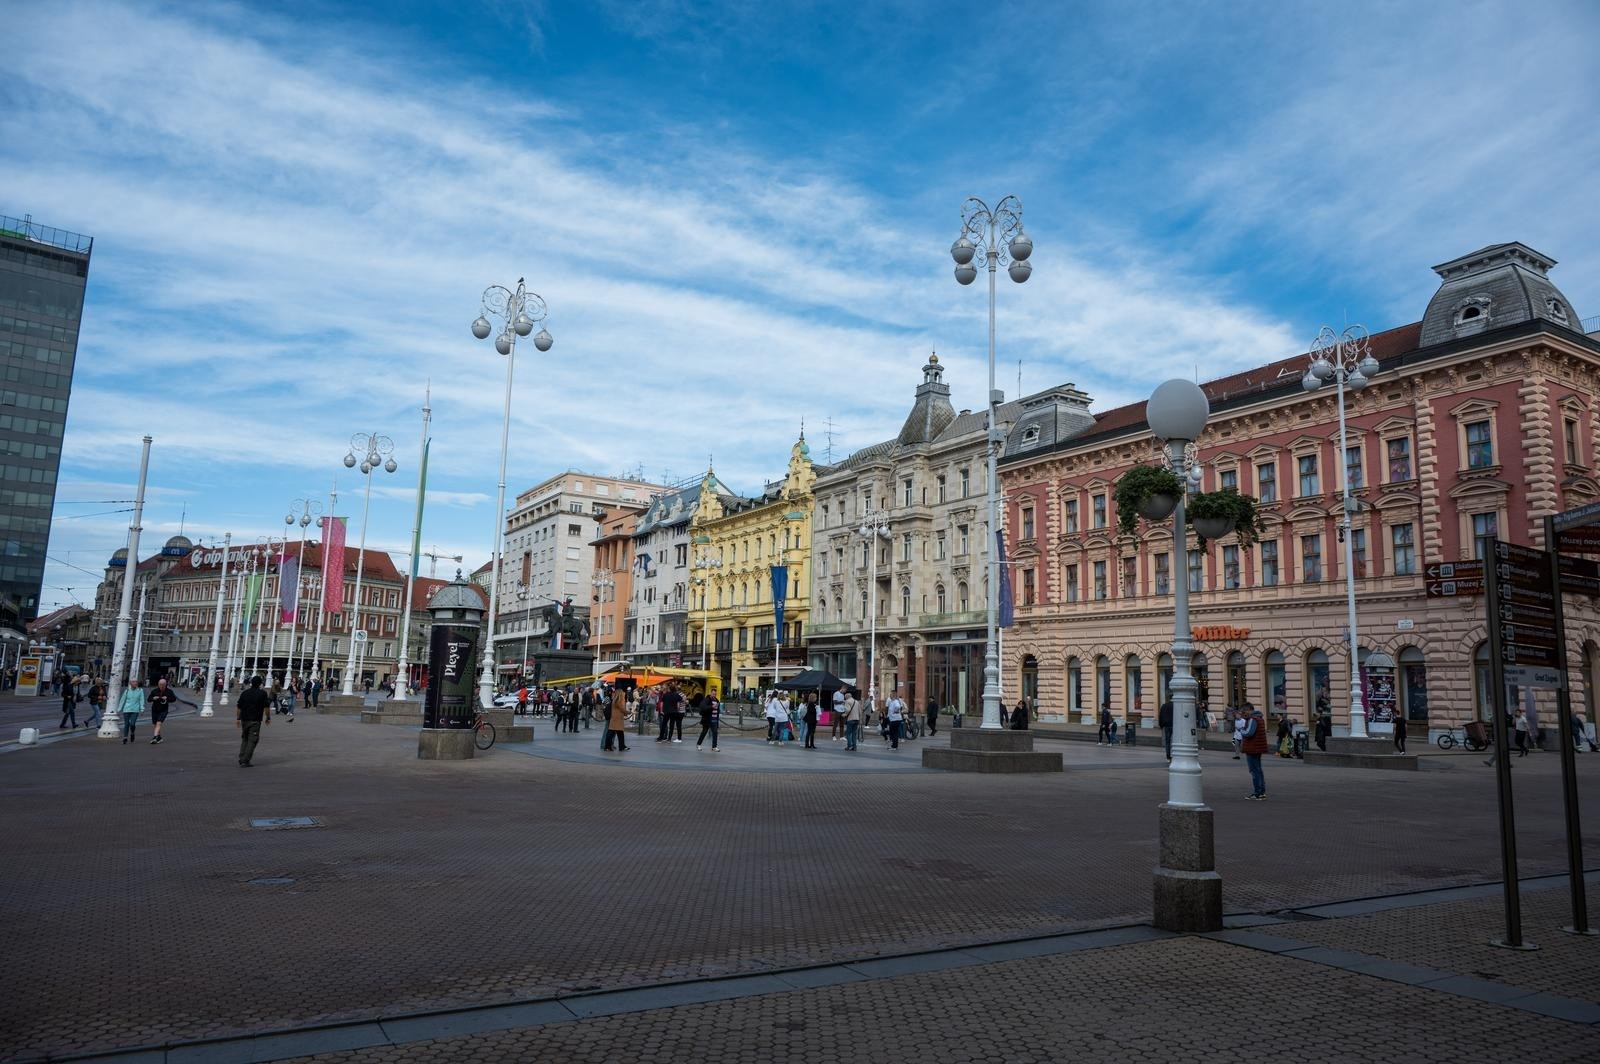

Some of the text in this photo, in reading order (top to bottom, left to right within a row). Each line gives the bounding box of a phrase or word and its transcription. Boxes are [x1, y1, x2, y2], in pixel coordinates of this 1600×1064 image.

[1560, 536, 1582, 546] Muzej
[1457, 580, 1479, 589] Muzej
[1192, 625, 1249, 641] Müller
[444, 642, 460, 676] Pleyel
